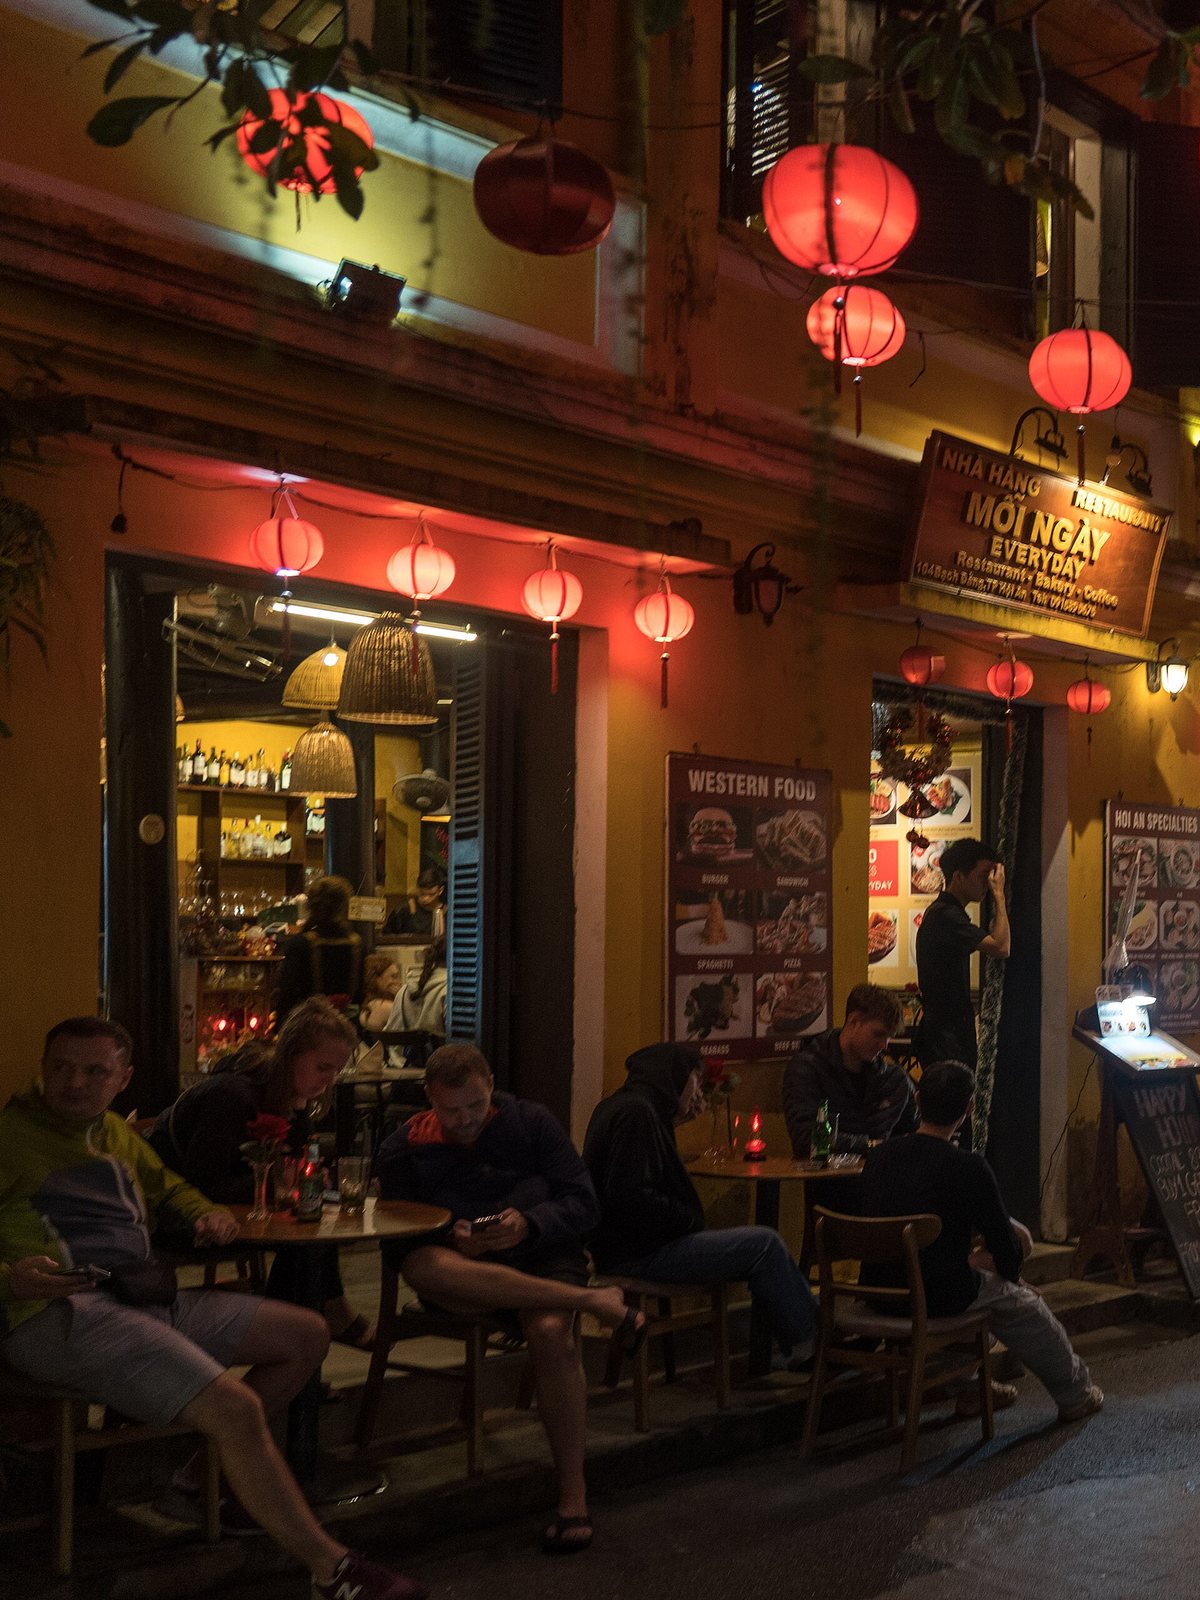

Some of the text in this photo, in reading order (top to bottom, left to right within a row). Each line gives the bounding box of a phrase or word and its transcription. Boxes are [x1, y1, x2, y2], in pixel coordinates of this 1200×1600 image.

[943, 447, 1042, 497] NHÀ HÀNG
[965, 491, 1112, 561] MỖI NGÀY
[1073, 489, 1167, 533] RESTAURANT
[956, 550, 1119, 608] Restaurant Bakery Coffee
[990, 535, 1086, 580] EVERYDAY
[688, 768, 817, 802] WESTERN FOOD
[1114, 809, 1198, 834] HOI AN SPECIALTIES
